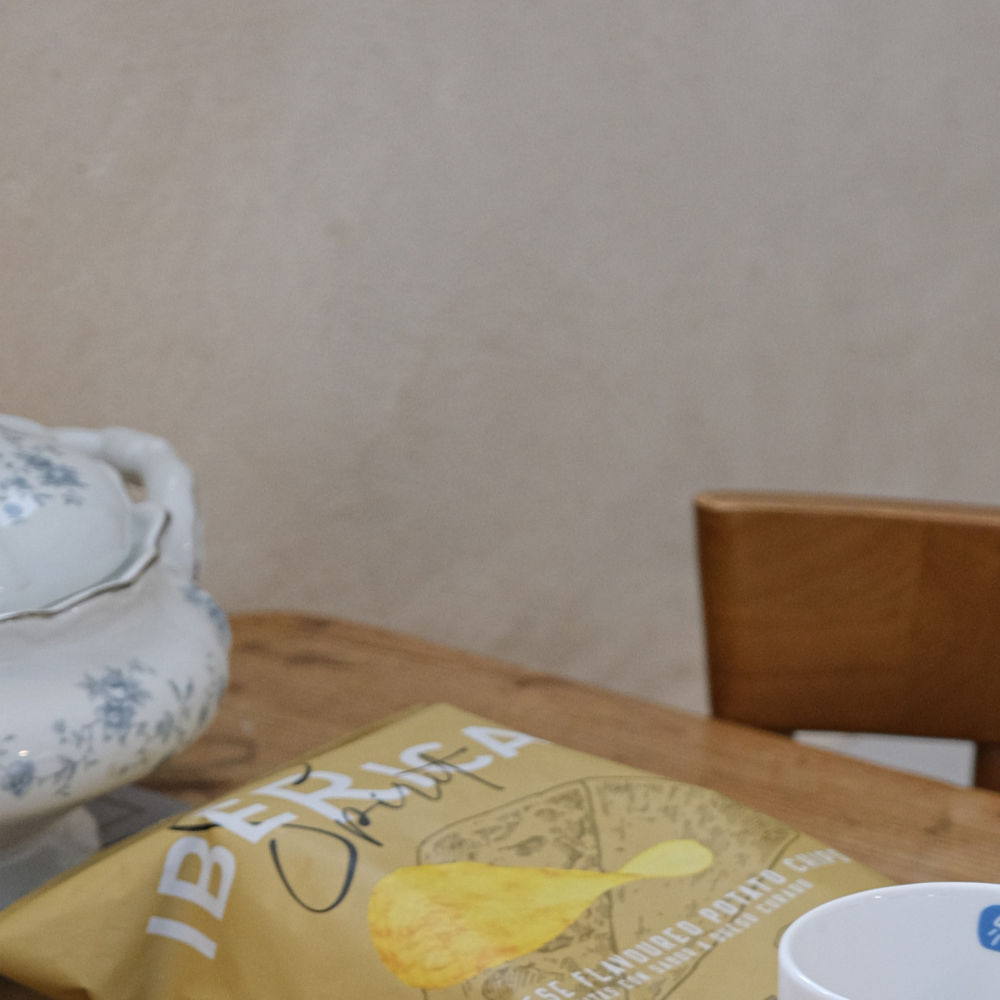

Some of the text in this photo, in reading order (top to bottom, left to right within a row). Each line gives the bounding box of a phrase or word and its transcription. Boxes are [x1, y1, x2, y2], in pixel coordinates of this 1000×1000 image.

[146, 726, 538, 960] IBERICA
[571, 920, 702, 988] FLAVOURED
[699, 869, 788, 925] POTATO
[782, 847, 852, 873] CHIPS
